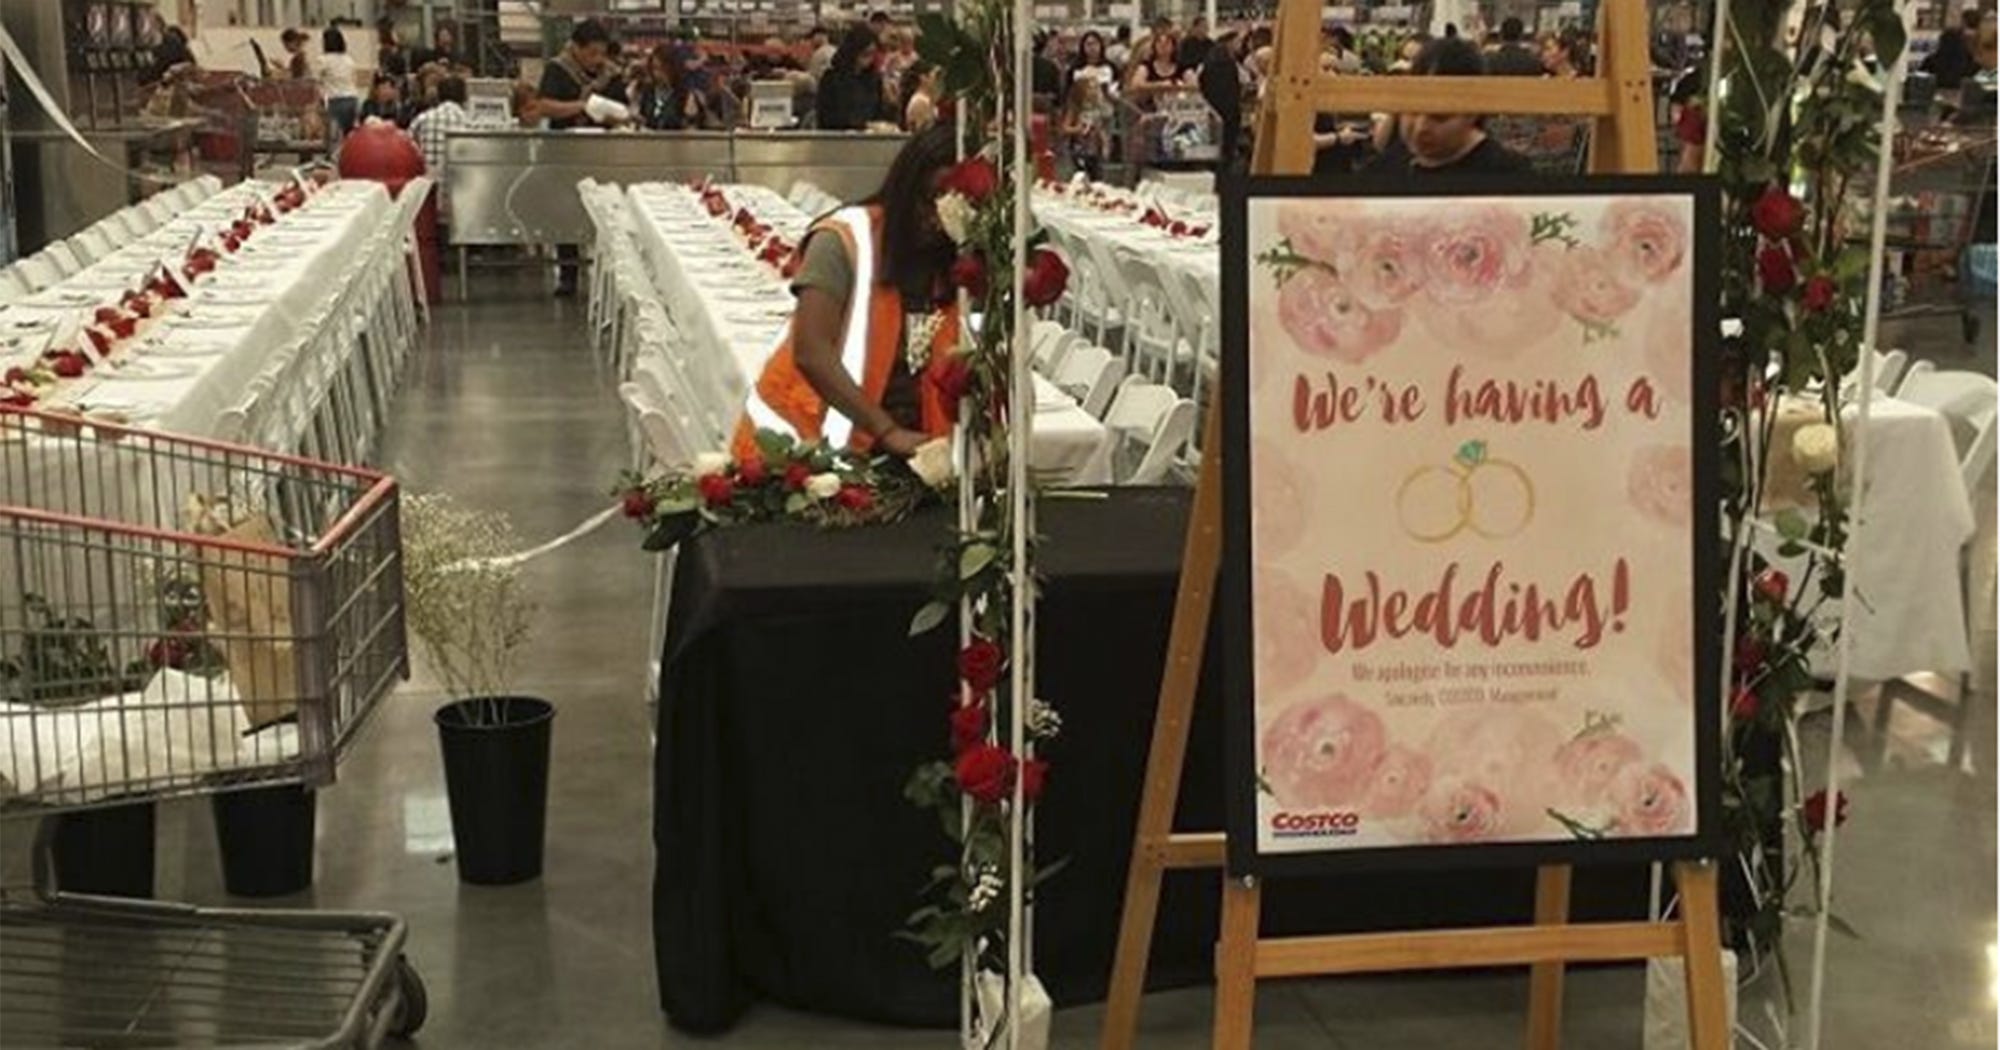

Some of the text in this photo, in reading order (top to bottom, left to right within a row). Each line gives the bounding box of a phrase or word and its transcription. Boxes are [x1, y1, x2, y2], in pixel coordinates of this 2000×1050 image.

[1293, 364, 1661, 433] We're having a
[1320, 556, 1629, 654] Wedding!
[1272, 812, 1359, 830] COSTCO
